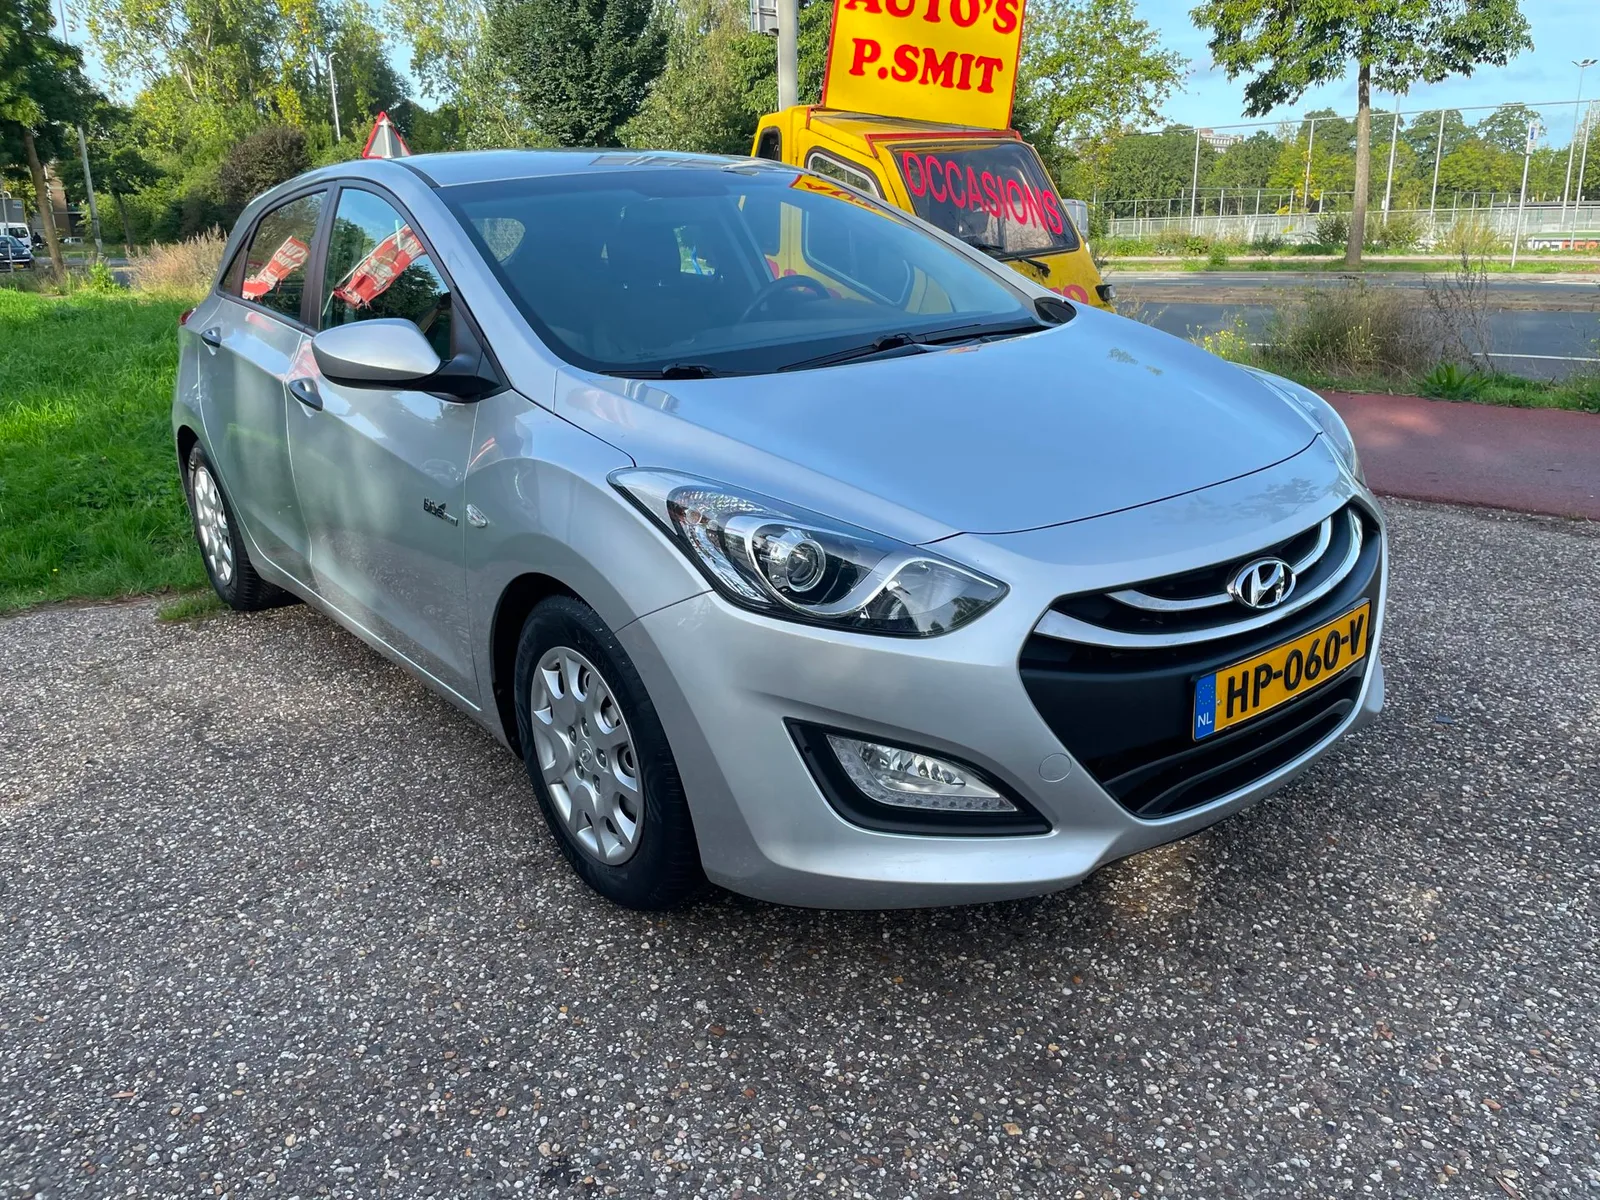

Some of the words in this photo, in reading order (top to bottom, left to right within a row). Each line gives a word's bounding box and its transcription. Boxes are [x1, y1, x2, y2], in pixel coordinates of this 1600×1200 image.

[849, 38, 1003, 93] P.SMIT
[902, 151, 1063, 235] OCCASIONS
[1226, 613, 1364, 719] HP-060-V
[1197, 711, 1213, 728] NL
